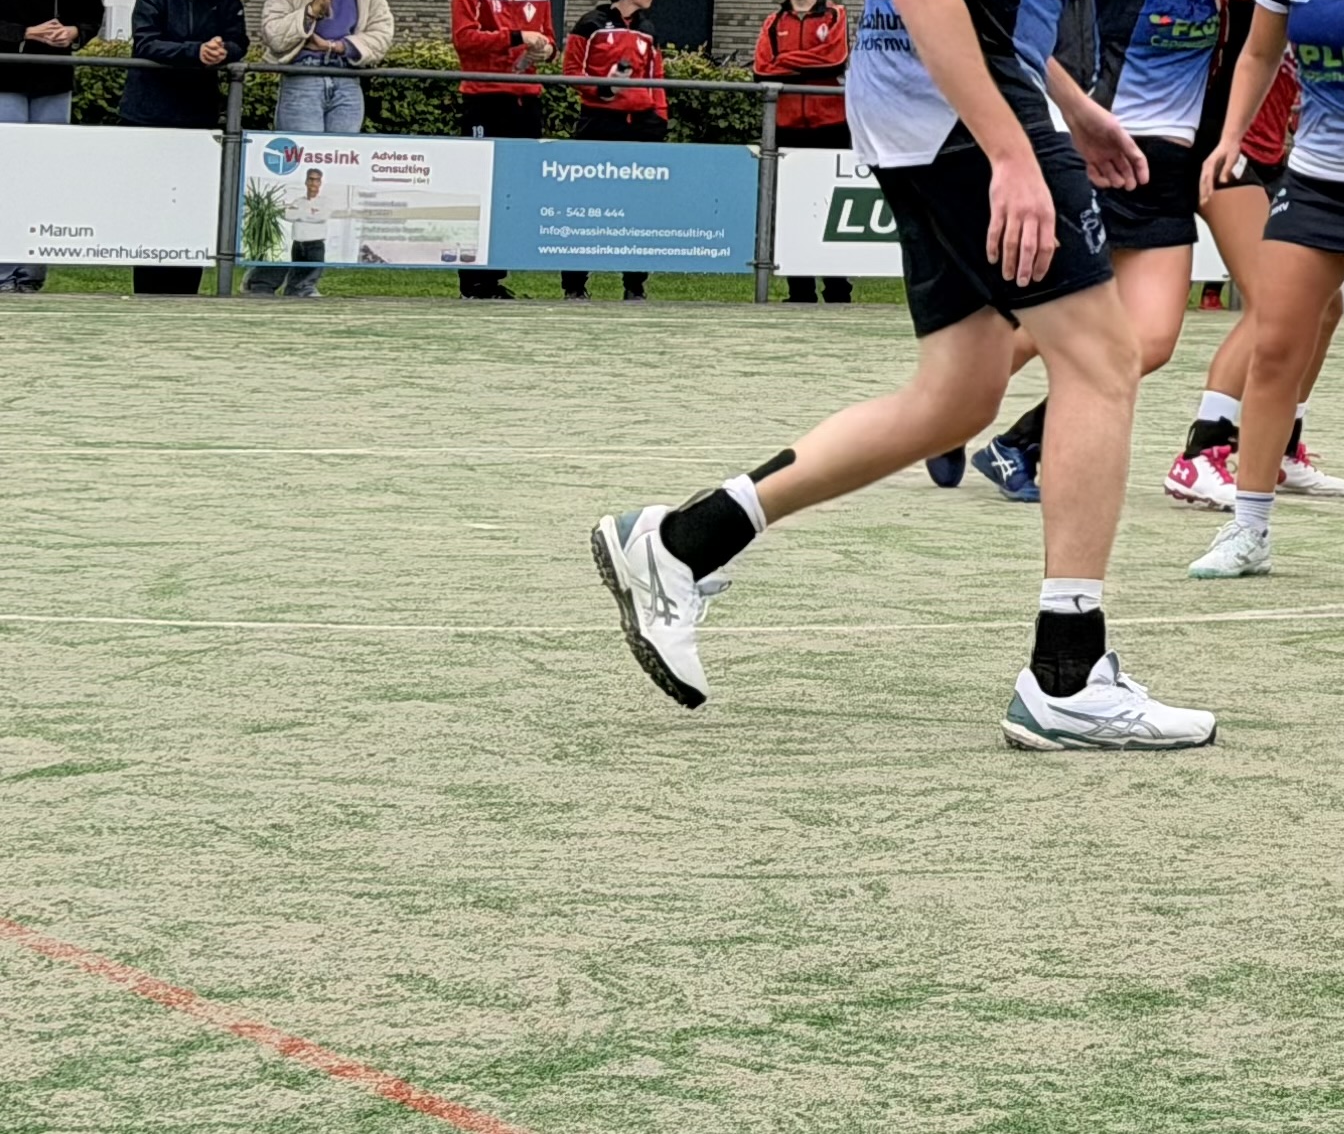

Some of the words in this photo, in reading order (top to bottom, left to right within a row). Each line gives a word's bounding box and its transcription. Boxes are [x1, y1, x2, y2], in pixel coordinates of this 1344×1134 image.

[472, 125, 484, 138] 19
[284, 145, 360, 165] Wassink
[371, 151, 409, 161] Advies
[411, 153, 425, 162] en
[371, 164, 430, 176] Consulting
[542, 160, 670, 182] Hypotheken
[540, 207, 555, 217] 06
[566, 207, 585, 218] 542
[39, 224, 94, 238] Marum
[38, 244, 210, 263] www.nienhuissport.nl
